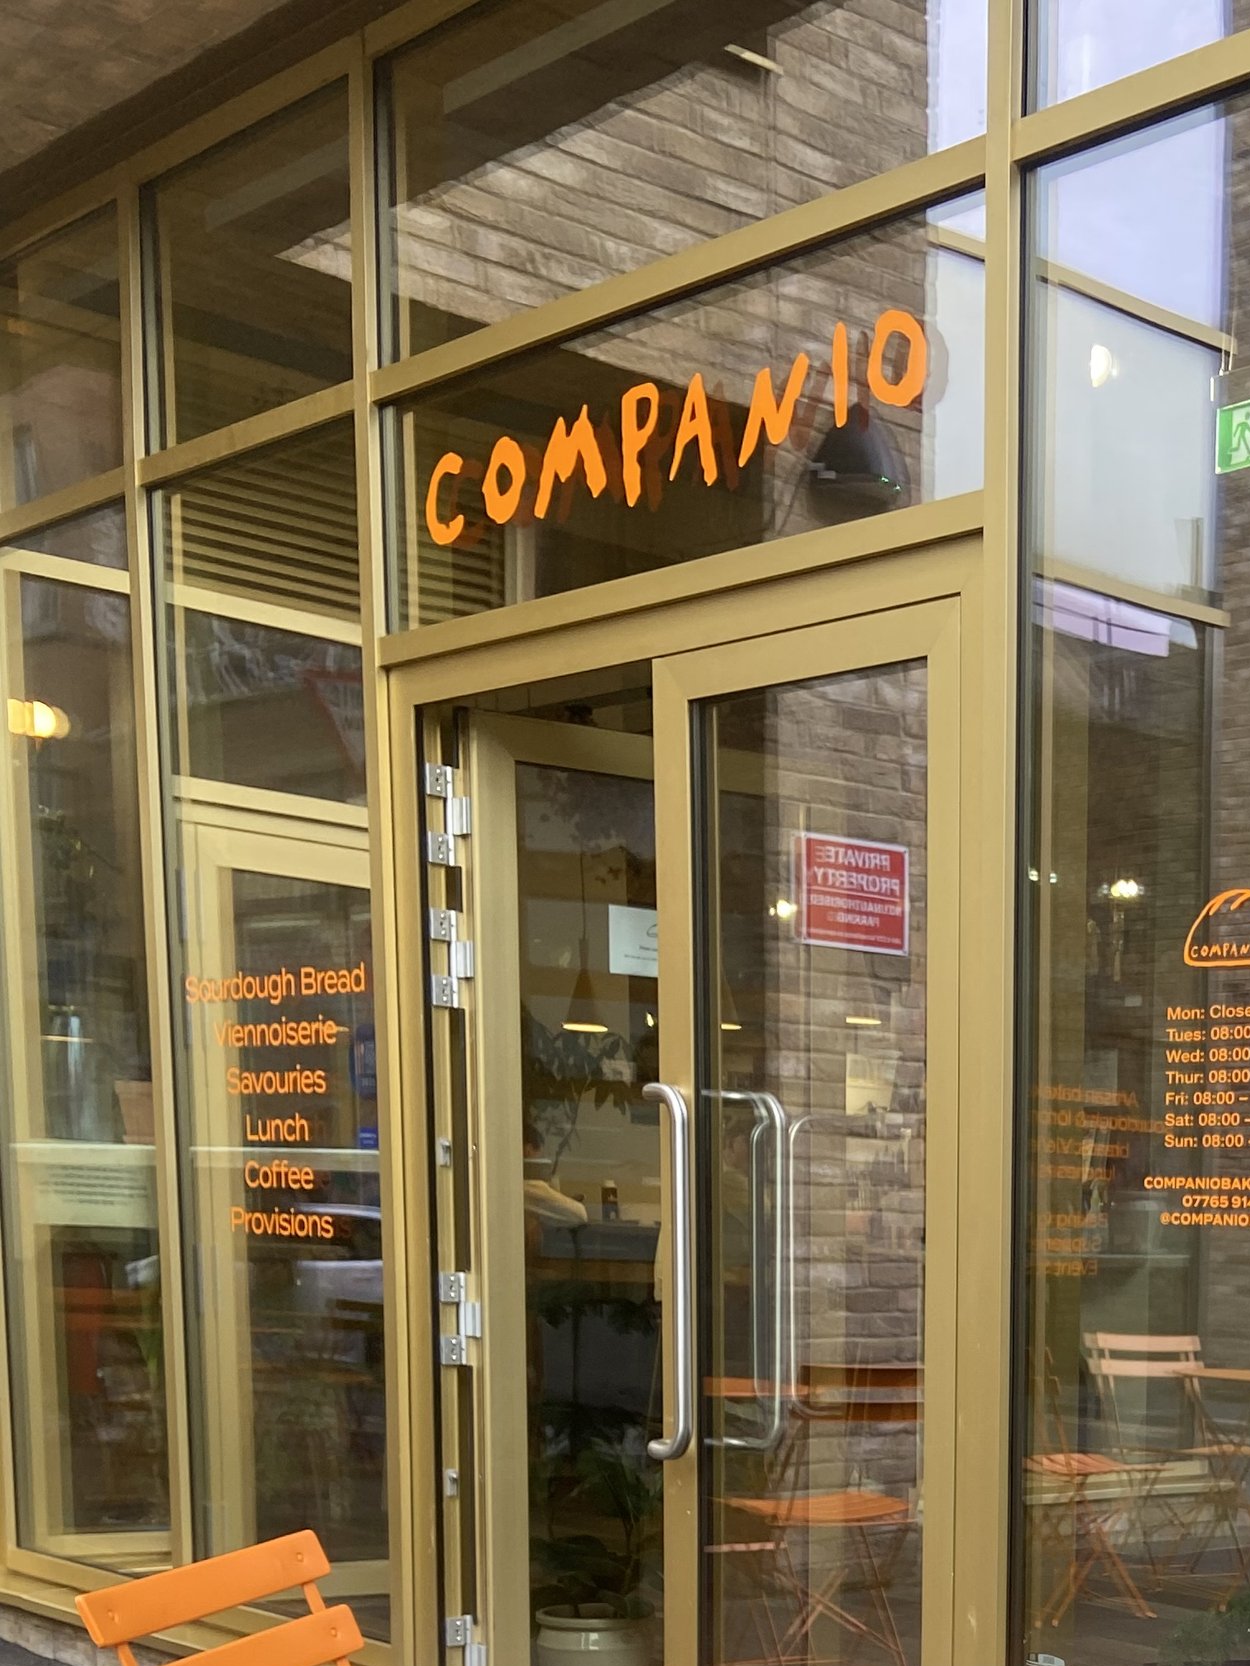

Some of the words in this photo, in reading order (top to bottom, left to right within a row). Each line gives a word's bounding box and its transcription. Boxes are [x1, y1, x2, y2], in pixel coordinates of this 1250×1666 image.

[426, 309, 927, 546] COMPANIO
[185, 968, 295, 1005] Sourdough
[301, 962, 366, 995] Bread
[1166, 1006, 1204, 1020] Mon:
[212, 1014, 337, 1047] Viennoiserie
[1165, 1027, 1206, 1042] Tues:
[1165, 1048, 1204, 1063] Wed:
[226, 1064, 327, 1094] Savouries
[1165, 1071, 1205, 1085] Thur:
[1165, 1092, 1188, 1106] Fri:
[1193, 1091, 1235, 1105] 08:00
[1164, 1113, 1194, 1127] Sat:
[1198, 1112, 1240, 1126] 08:00
[245, 1113, 310, 1142] Lunch
[1164, 1135, 1197, 1148] Sun:
[1202, 1133, 1244, 1148] 08:00
[244, 1159, 315, 1190] Coffee
[1181, 1194, 1229, 1209] 07765
[229, 1206, 334, 1239] Provisions
